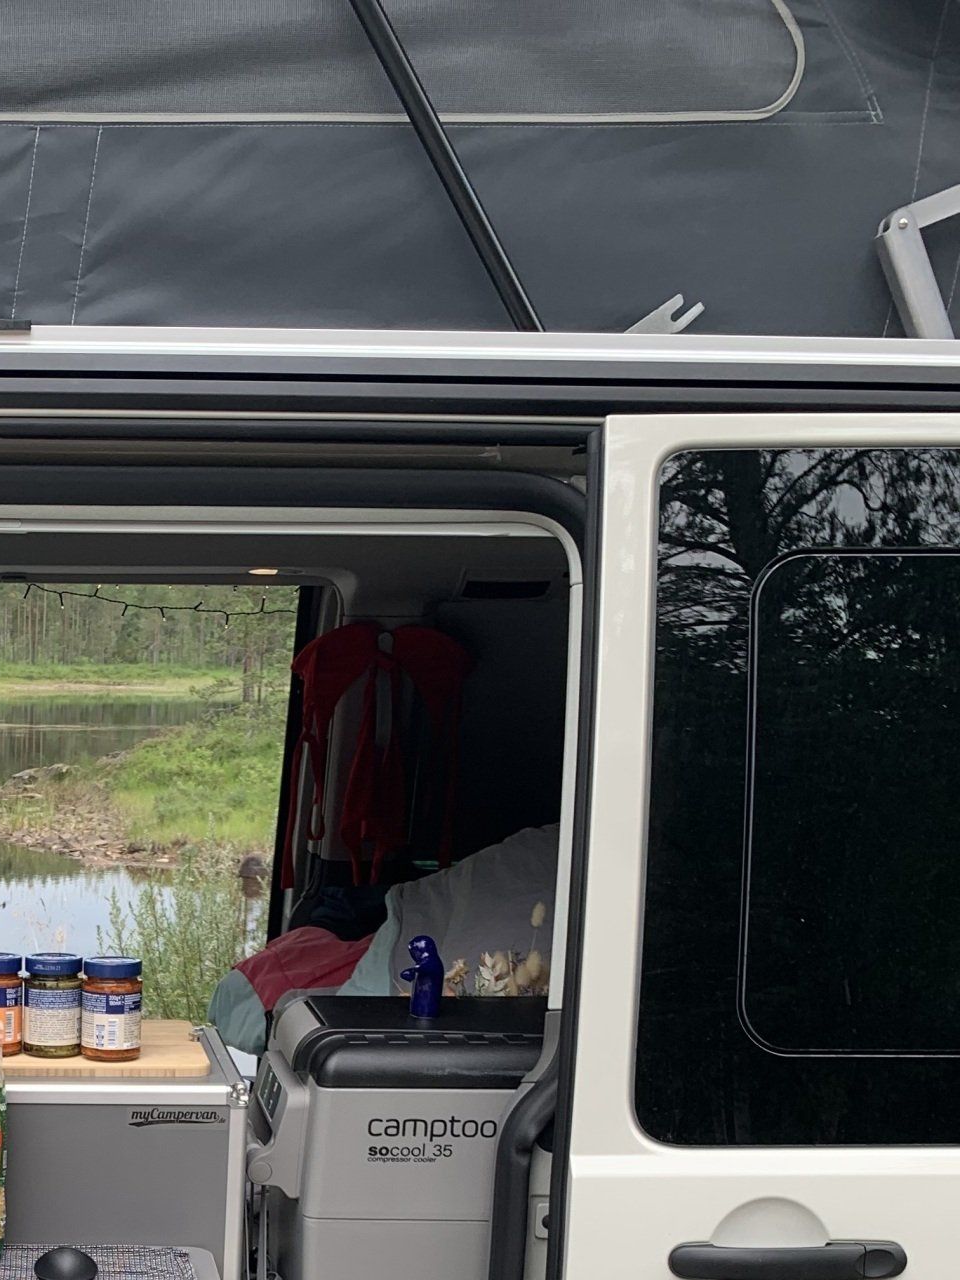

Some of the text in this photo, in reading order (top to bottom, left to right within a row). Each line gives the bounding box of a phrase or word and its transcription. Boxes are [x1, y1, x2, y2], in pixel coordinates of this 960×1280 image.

[367, 1115, 498, 1143] camptoo
[367, 1143, 454, 1158] socool 35
